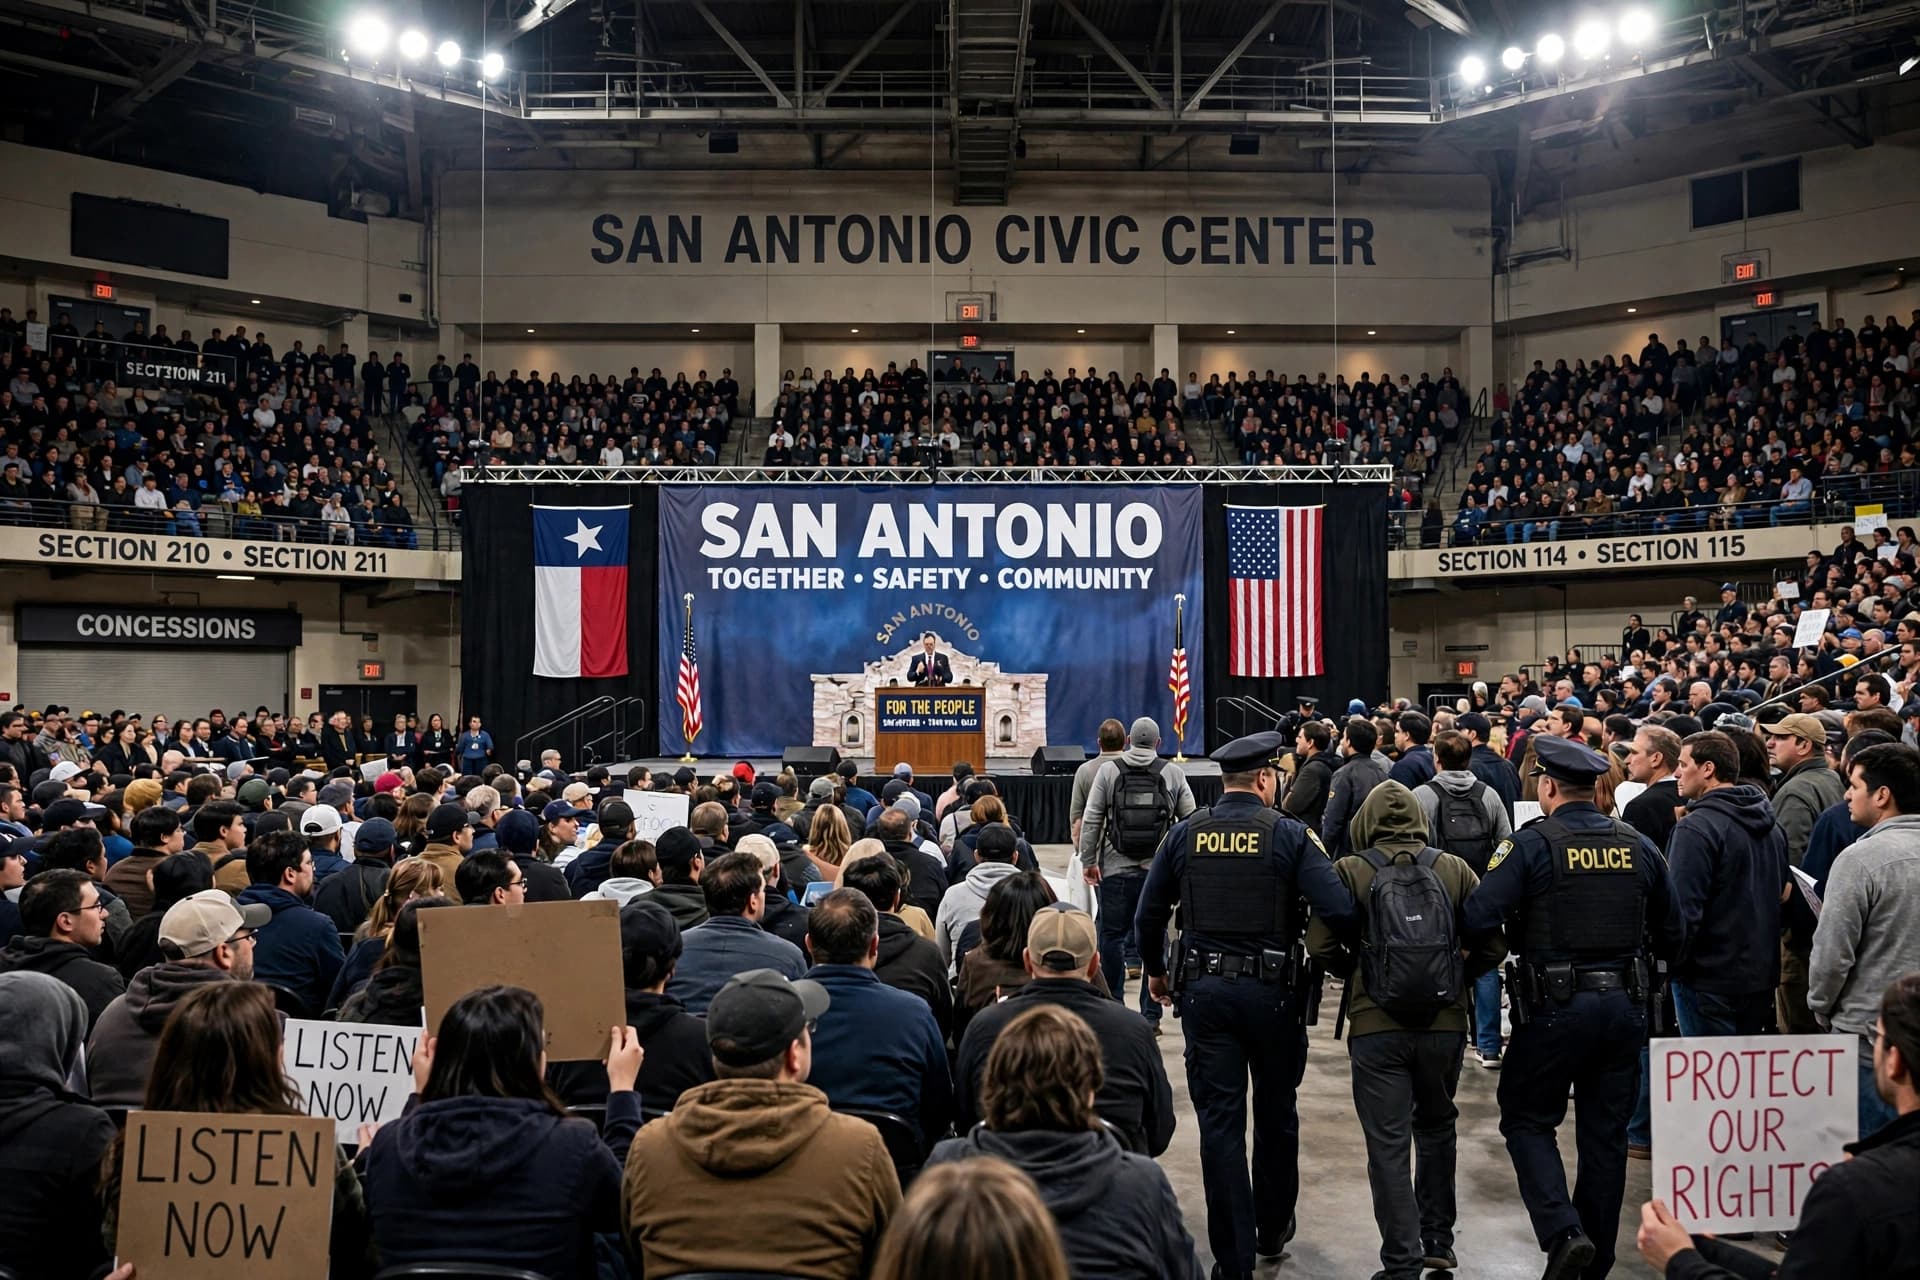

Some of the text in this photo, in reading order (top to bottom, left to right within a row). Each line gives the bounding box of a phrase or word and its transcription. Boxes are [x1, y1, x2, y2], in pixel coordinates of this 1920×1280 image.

[591, 214, 1377, 266] SAN ANTONIO CIVIC CENTER
[206, 370, 227, 385] 211
[699, 502, 1163, 559] SAN ANTONIO
[38, 534, 387, 573] SECTION 210 SECTION 211
[1438, 535, 1746, 572] SECTION 114 SECTION 115
[708, 567, 1154, 590] TOGETHER SAFETY COMMUNITY
[76, 614, 256, 640] CONCESSIONS
[876, 602, 980, 645] SAN ANTONIO
[886, 700, 975, 715] FOR THE PEOPLE
[1196, 832, 1259, 853] POLICE
[1567, 847, 1633, 870] POLICE
[295, 1028, 417, 1075] LISTEN
[1666, 1049, 1845, 1102] PROTECT
[308, 1080, 388, 1122] NOW
[1708, 1108, 1786, 1154] OUR
[136, 1124, 321, 1188] LISTEN
[164, 1201, 286, 1260] NOW
